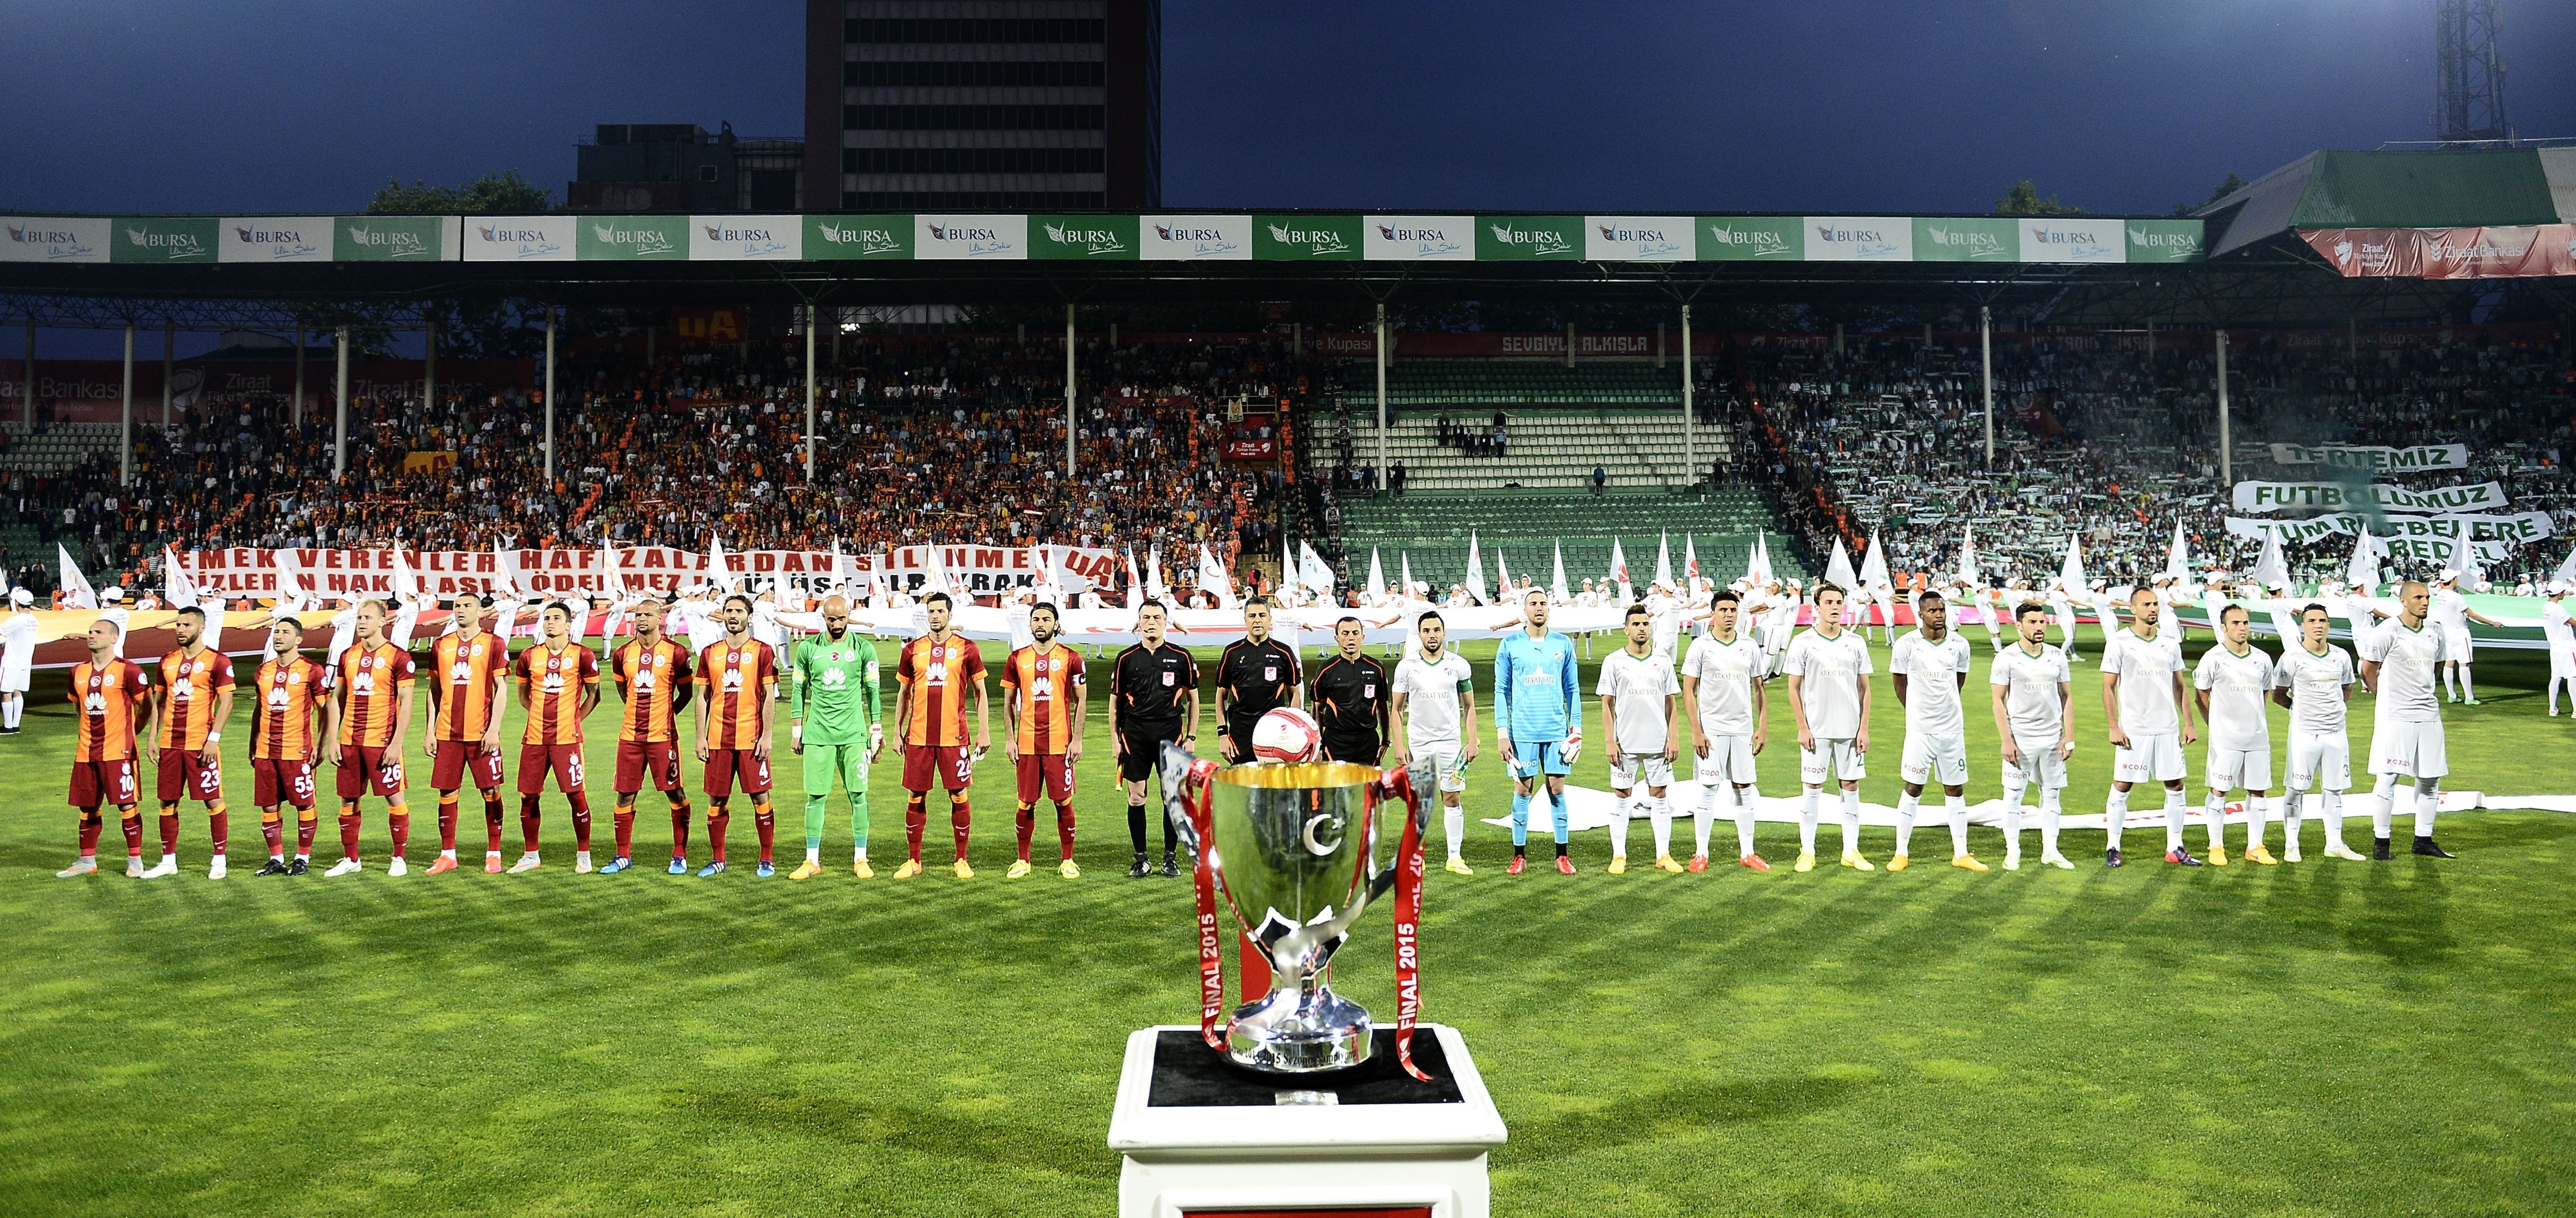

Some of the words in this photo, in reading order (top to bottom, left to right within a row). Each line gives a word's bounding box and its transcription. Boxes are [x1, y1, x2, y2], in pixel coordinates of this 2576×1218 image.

[28, 231, 77, 243] BURSA
[149, 234, 197, 246] BURSA
[256, 231, 301, 243] BURSA
[371, 233, 420, 245] BURSA
[499, 230, 546, 241] BURSA
[616, 231, 665, 243] BURSA
[725, 229, 772, 241] BURSA
[842, 230, 892, 243] BURSA
[949, 229, 996, 240] BURSA
[1067, 230, 1117, 243] BURSA
[1175, 229, 1222, 241] BURSA
[1291, 231, 1341, 243] BURSA
[1398, 229, 1445, 241] BURSA
[1514, 231, 1563, 244] BURSA
[1619, 230, 1666, 241] BURSA
[1733, 232, 1782, 244] BURSA
[1837, 230, 1882, 242] BURSA
[1950, 233, 1997, 245] BURSA
[2052, 233, 2096, 244] BURSA
[2149, 234, 2195, 247] BURSA
[2362, 244, 2384, 253] Ziraat
[2445, 246, 2478, 258] Ziraat
[2479, 245, 2524, 258] Bankası
[1328, 337, 1371, 353] Kupası
[1502, 336, 1568, 352] SEVGİYL
[1582, 336, 1647, 354] ALKIŞLA
[225, 373, 272, 389] Ziraat
[40, 377, 123, 399] Bankası
[2286, 447, 2451, 468] TERTEMİZ
[2255, 485, 2491, 508] FUTBOLUMUZ
[177, 549, 277, 571] EMEK
[296, 549, 496, 573] VERENLER
[488, 756, 501, 774] 17
[670, 761, 678, 777] 3
[956, 758, 972, 777] 22
[1521, 759, 1537, 767] opa
[1958, 759, 1966, 771] 9
[381, 763, 401, 784] 26
[568, 763, 583, 782] 13
[759, 761, 769, 779] 4
[1064, 768, 1072, 785] 8
[1907, 765, 1926, 775] copa
[119, 775, 134, 792] 10
[200, 769, 220, 787] 23
[294, 774, 313, 793] 55
[1201, 913, 1218, 959] 2015
[1397, 923, 1416, 970] 2015
[1398, 973, 1417, 1031] FİNAL
